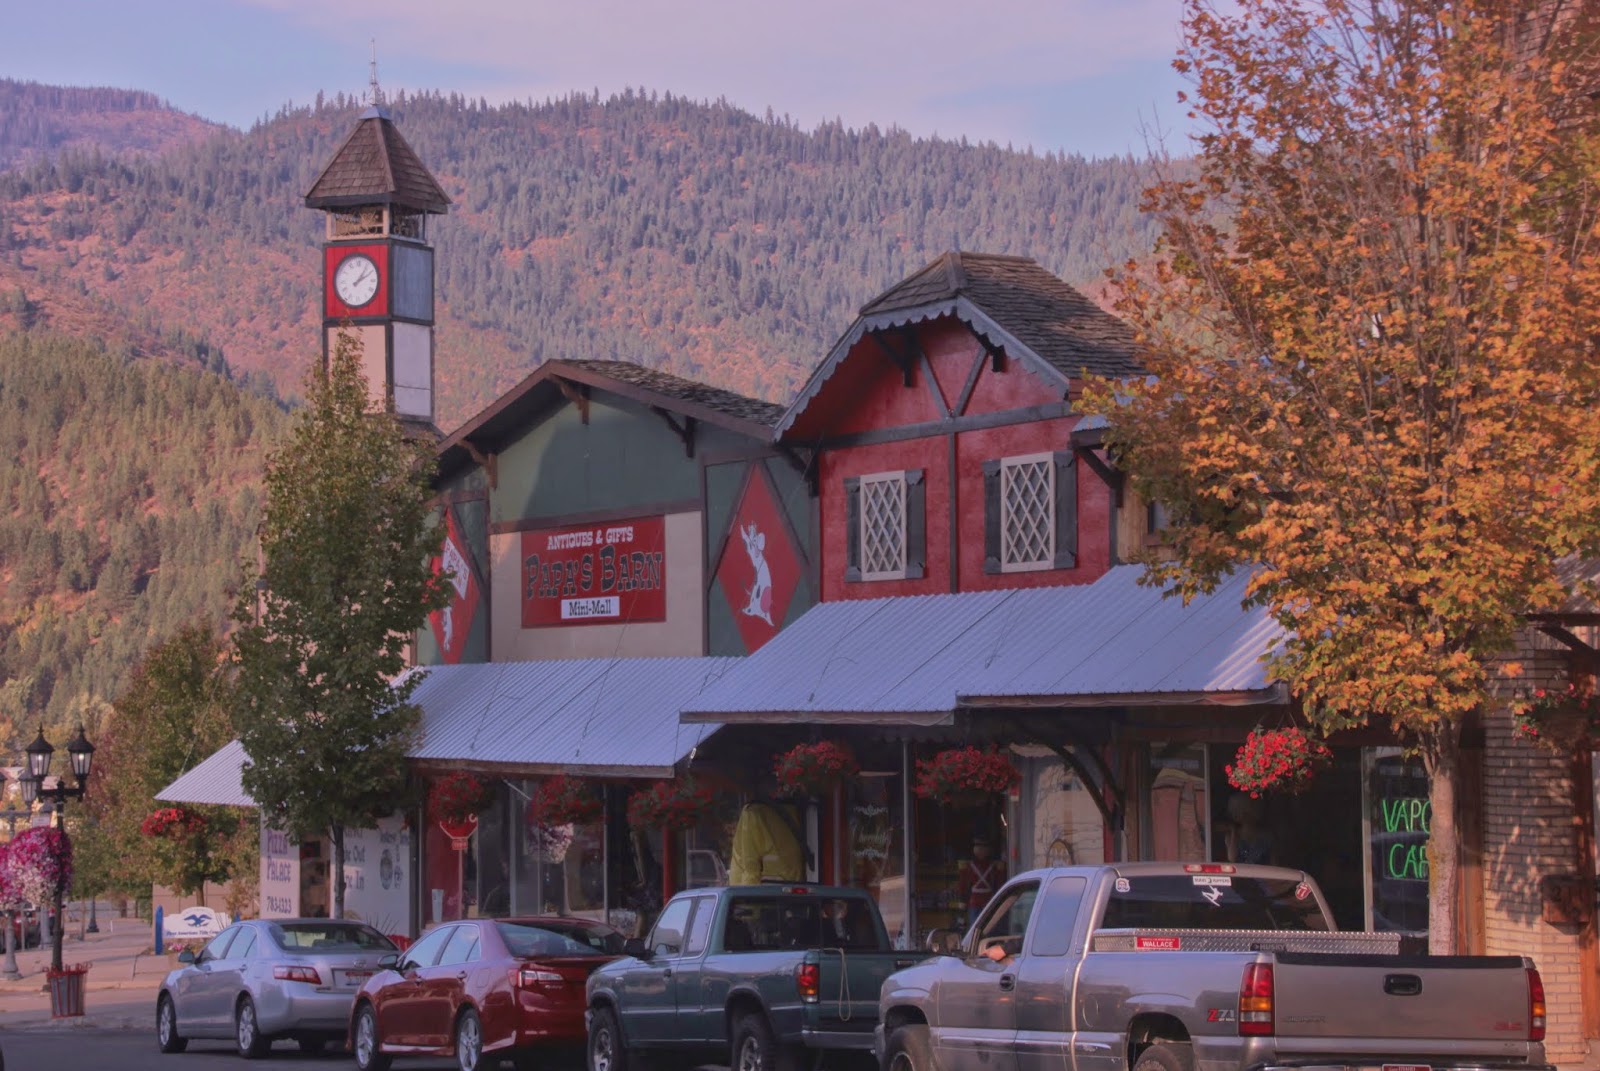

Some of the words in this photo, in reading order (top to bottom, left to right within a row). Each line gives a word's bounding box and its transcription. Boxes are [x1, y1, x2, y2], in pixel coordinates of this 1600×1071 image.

[547, 531, 593, 550] ANTIQUES
[595, 530, 603, 544] &
[606, 526, 633, 544] GIFTS
[525, 553, 594, 599] PAPA'S
[600, 544, 662, 592] BARN
[569, 600, 611, 616] Mini-Mall
[267, 855, 291, 882] PALACE
[1389, 843, 1429, 878] CAF
[1142, 940, 1173, 948] WALLACE
[1207, 1008, 1234, 1022] Z71
